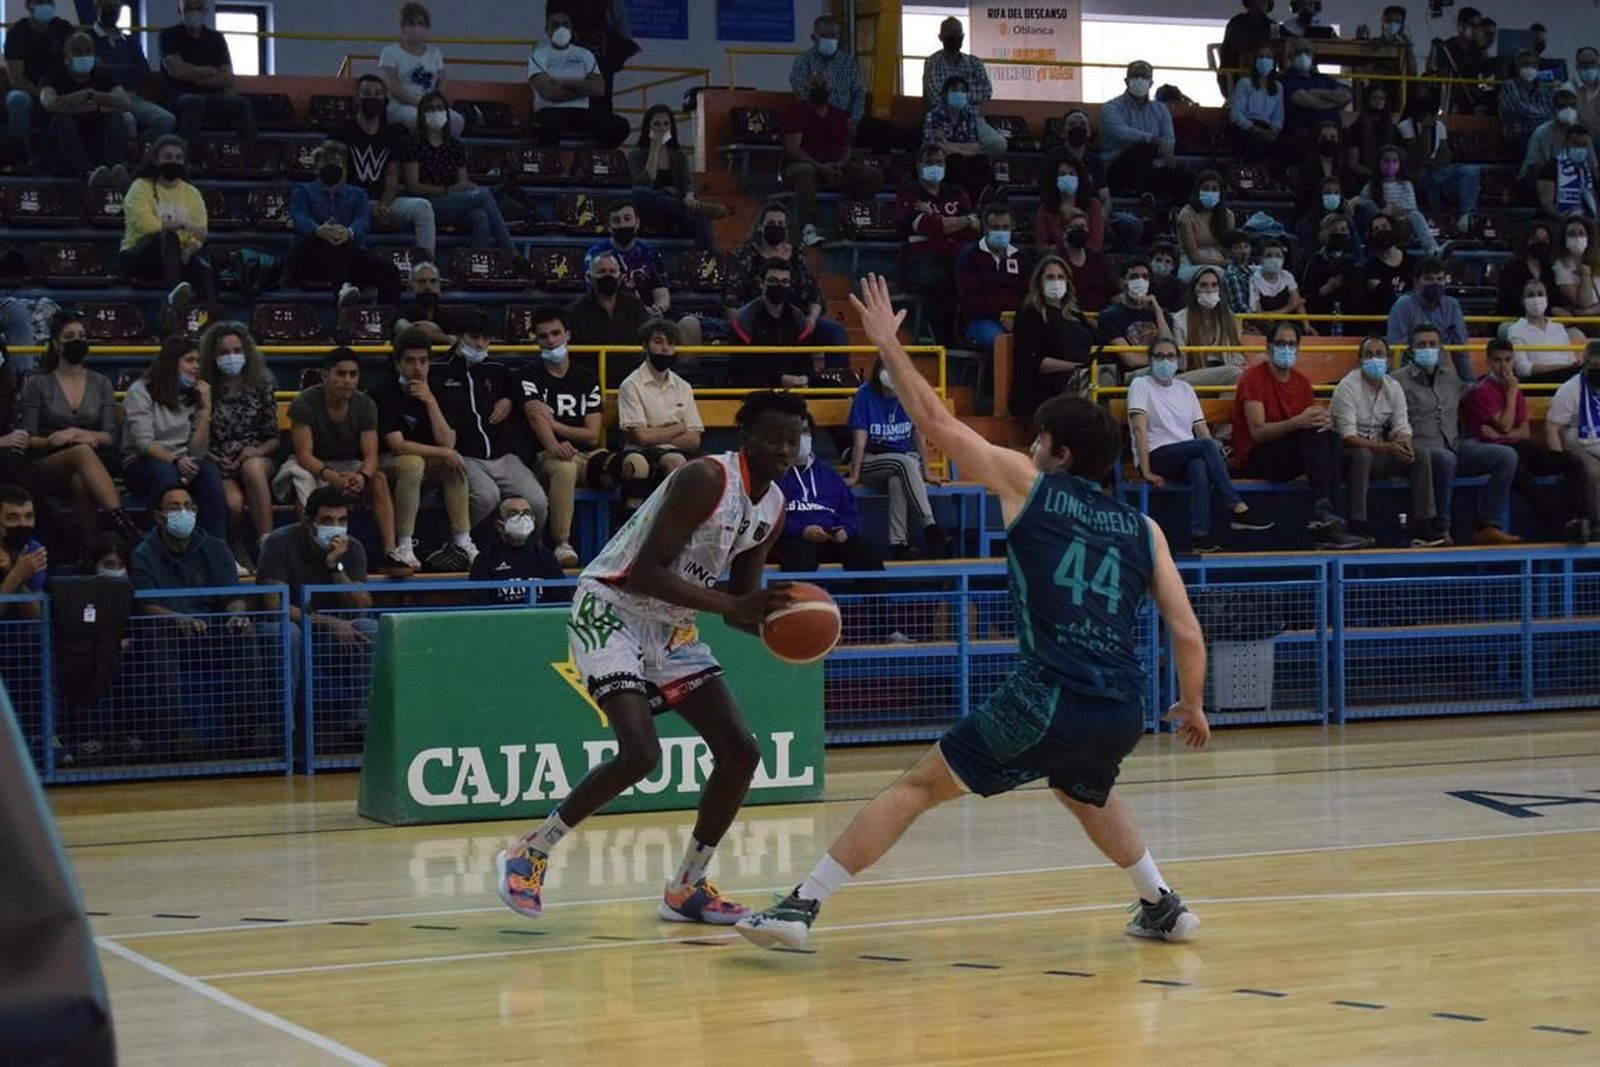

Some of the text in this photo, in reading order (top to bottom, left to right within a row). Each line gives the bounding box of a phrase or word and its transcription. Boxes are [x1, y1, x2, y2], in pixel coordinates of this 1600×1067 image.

[987, 8, 1067, 19] RIFA DEL DESCANSO
[1013, 25, 1054, 34] Oblanca
[95, 310, 115, 321] 42
[1053, 536, 1121, 614] 44
[407, 743, 573, 807] CAJA
